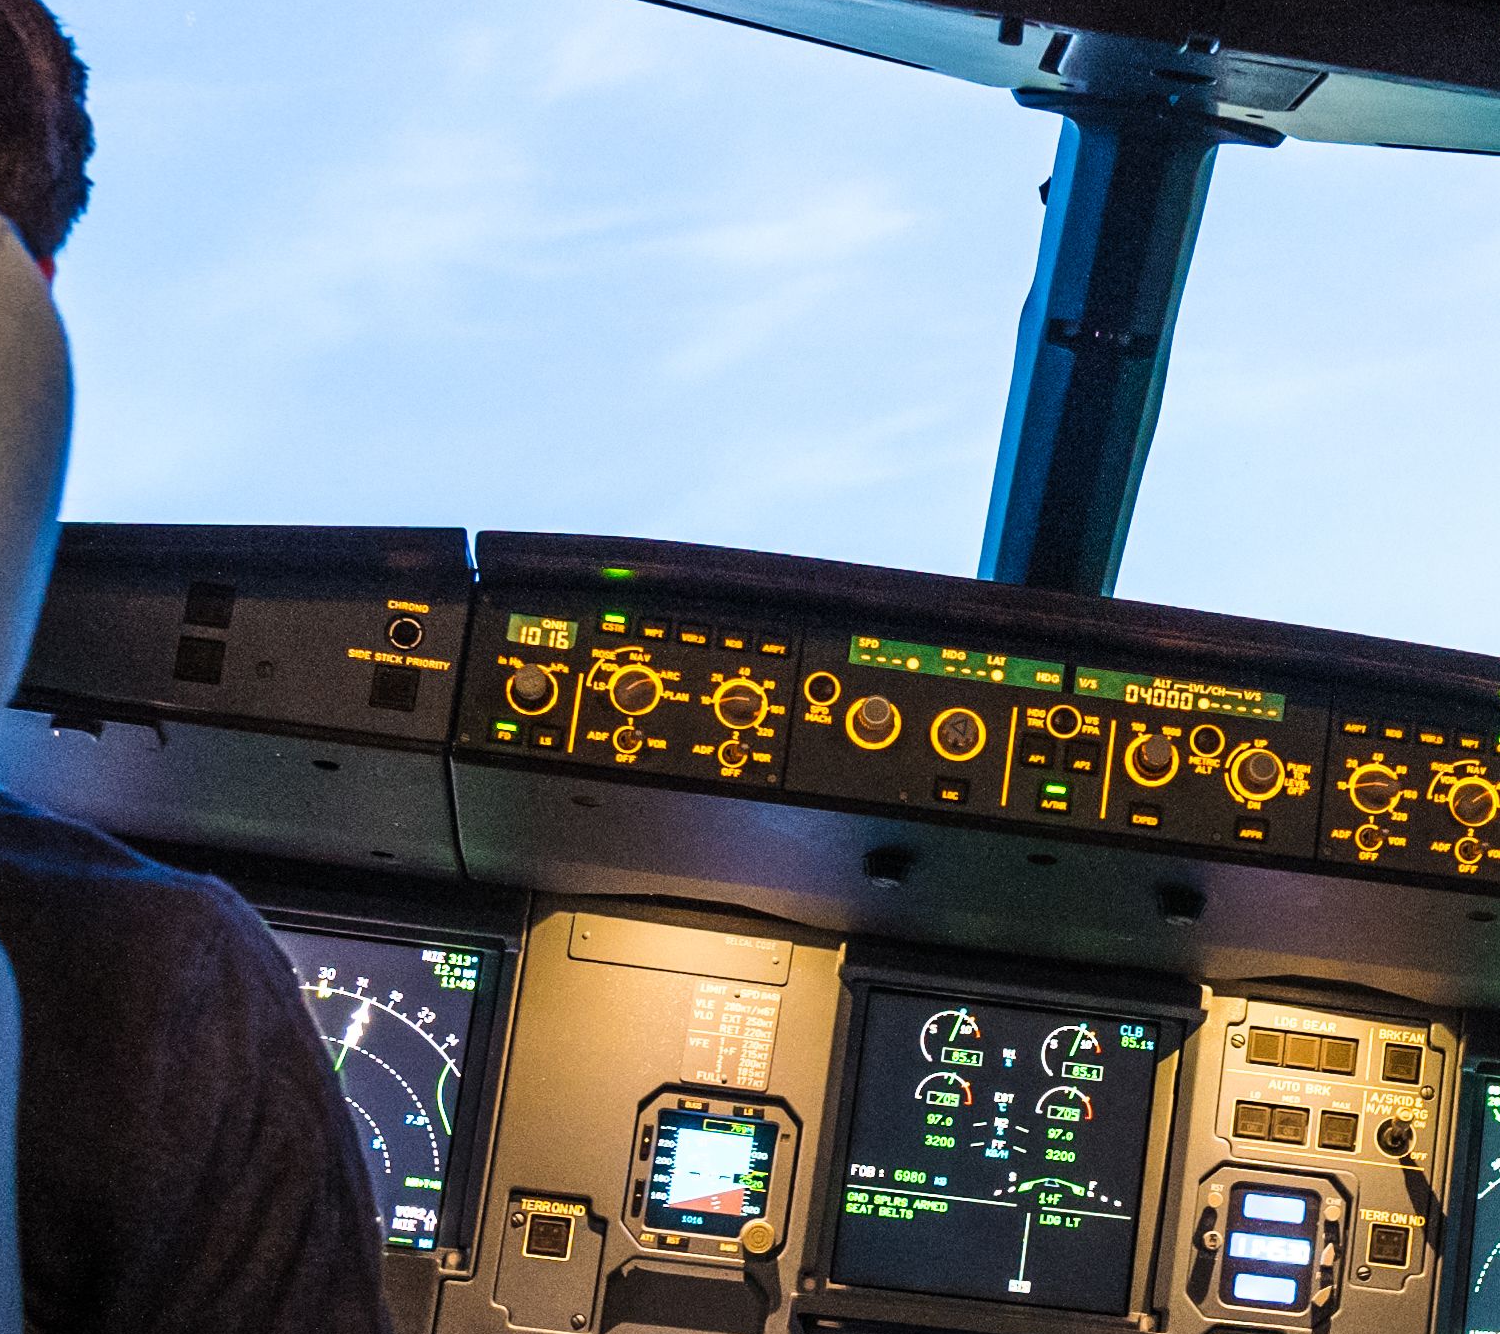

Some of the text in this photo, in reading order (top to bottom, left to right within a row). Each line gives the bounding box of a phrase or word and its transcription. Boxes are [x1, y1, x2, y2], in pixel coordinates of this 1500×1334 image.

[388, 599, 429, 614] CHRONO
[542, 619, 567, 630] QNH
[602, 623, 625, 633] CSTR
[630, 652, 651, 662] NAV
[859, 637, 1006, 666] SPD HDG LAT
[348, 648, 450, 671] SIDE STICK PRIORITY
[1036, 672, 1098, 689] HDG V/S
[664, 691, 689, 702] PLAN
[1153, 679, 1262, 702] ALT LVL/CH V/S
[1125, 684, 1193, 711] 04000
[810, 705, 829, 715] SPD
[805, 713, 831, 724] MACH
[587, 732, 609, 741] ADF
[692, 744, 715, 755] ADF
[1254, 739, 1268, 748] UP
[615, 753, 636, 763] OFF
[1188, 756, 1220, 767] METRIC
[1073, 760, 1091, 771] AP2
[1195, 765, 1212, 774] ALT
[1466, 766, 1487, 775] NAV
[721, 767, 742, 777] OFF
[1284, 778, 1310, 790] LEVEL
[1331, 829, 1352, 839] ADF
[1430, 843, 1451, 852] ADF
[1358, 852, 1379, 861] OFF
[1458, 864, 1478, 873] OFF
[319, 967, 336, 980] 30
[700, 983, 727, 994] LIMIT
[696, 999, 715, 1009] VLE
[694, 1010, 740, 1024] VLO EXT
[719, 1024, 740, 1034] RET
[1275, 1017, 1336, 1032] LDG GEAR
[1120, 1025, 1143, 1038] CLB
[689, 1038, 710, 1048] VFE
[697, 1071, 722, 1082] FULL
[1268, 1080, 1331, 1096] AUTO BRK
[936, 1093, 958, 1106] 705
[1370, 1093, 1411, 1105] A/SKID
[1057, 1107, 1079, 1119] 705
[1367, 1104, 1392, 1116] N/W
[927, 1114, 953, 1126] 97.0
[1047, 1129, 1074, 1141] 97.0
[925, 1135, 955, 1148] 3200
[1045, 1149, 1076, 1162] 3200
[1411, 1152, 1427, 1160] OFF
[894, 1170, 926, 1184] 6980
[521, 1199, 585, 1216] TERR ON ND
[847, 1192, 948, 1212] GND SPLRS ARMED
[846, 1203, 914, 1219] SEAT BELTS
[1039, 1214, 1081, 1228] LDG LT
[1359, 1210, 1425, 1227] TERR ON ND
